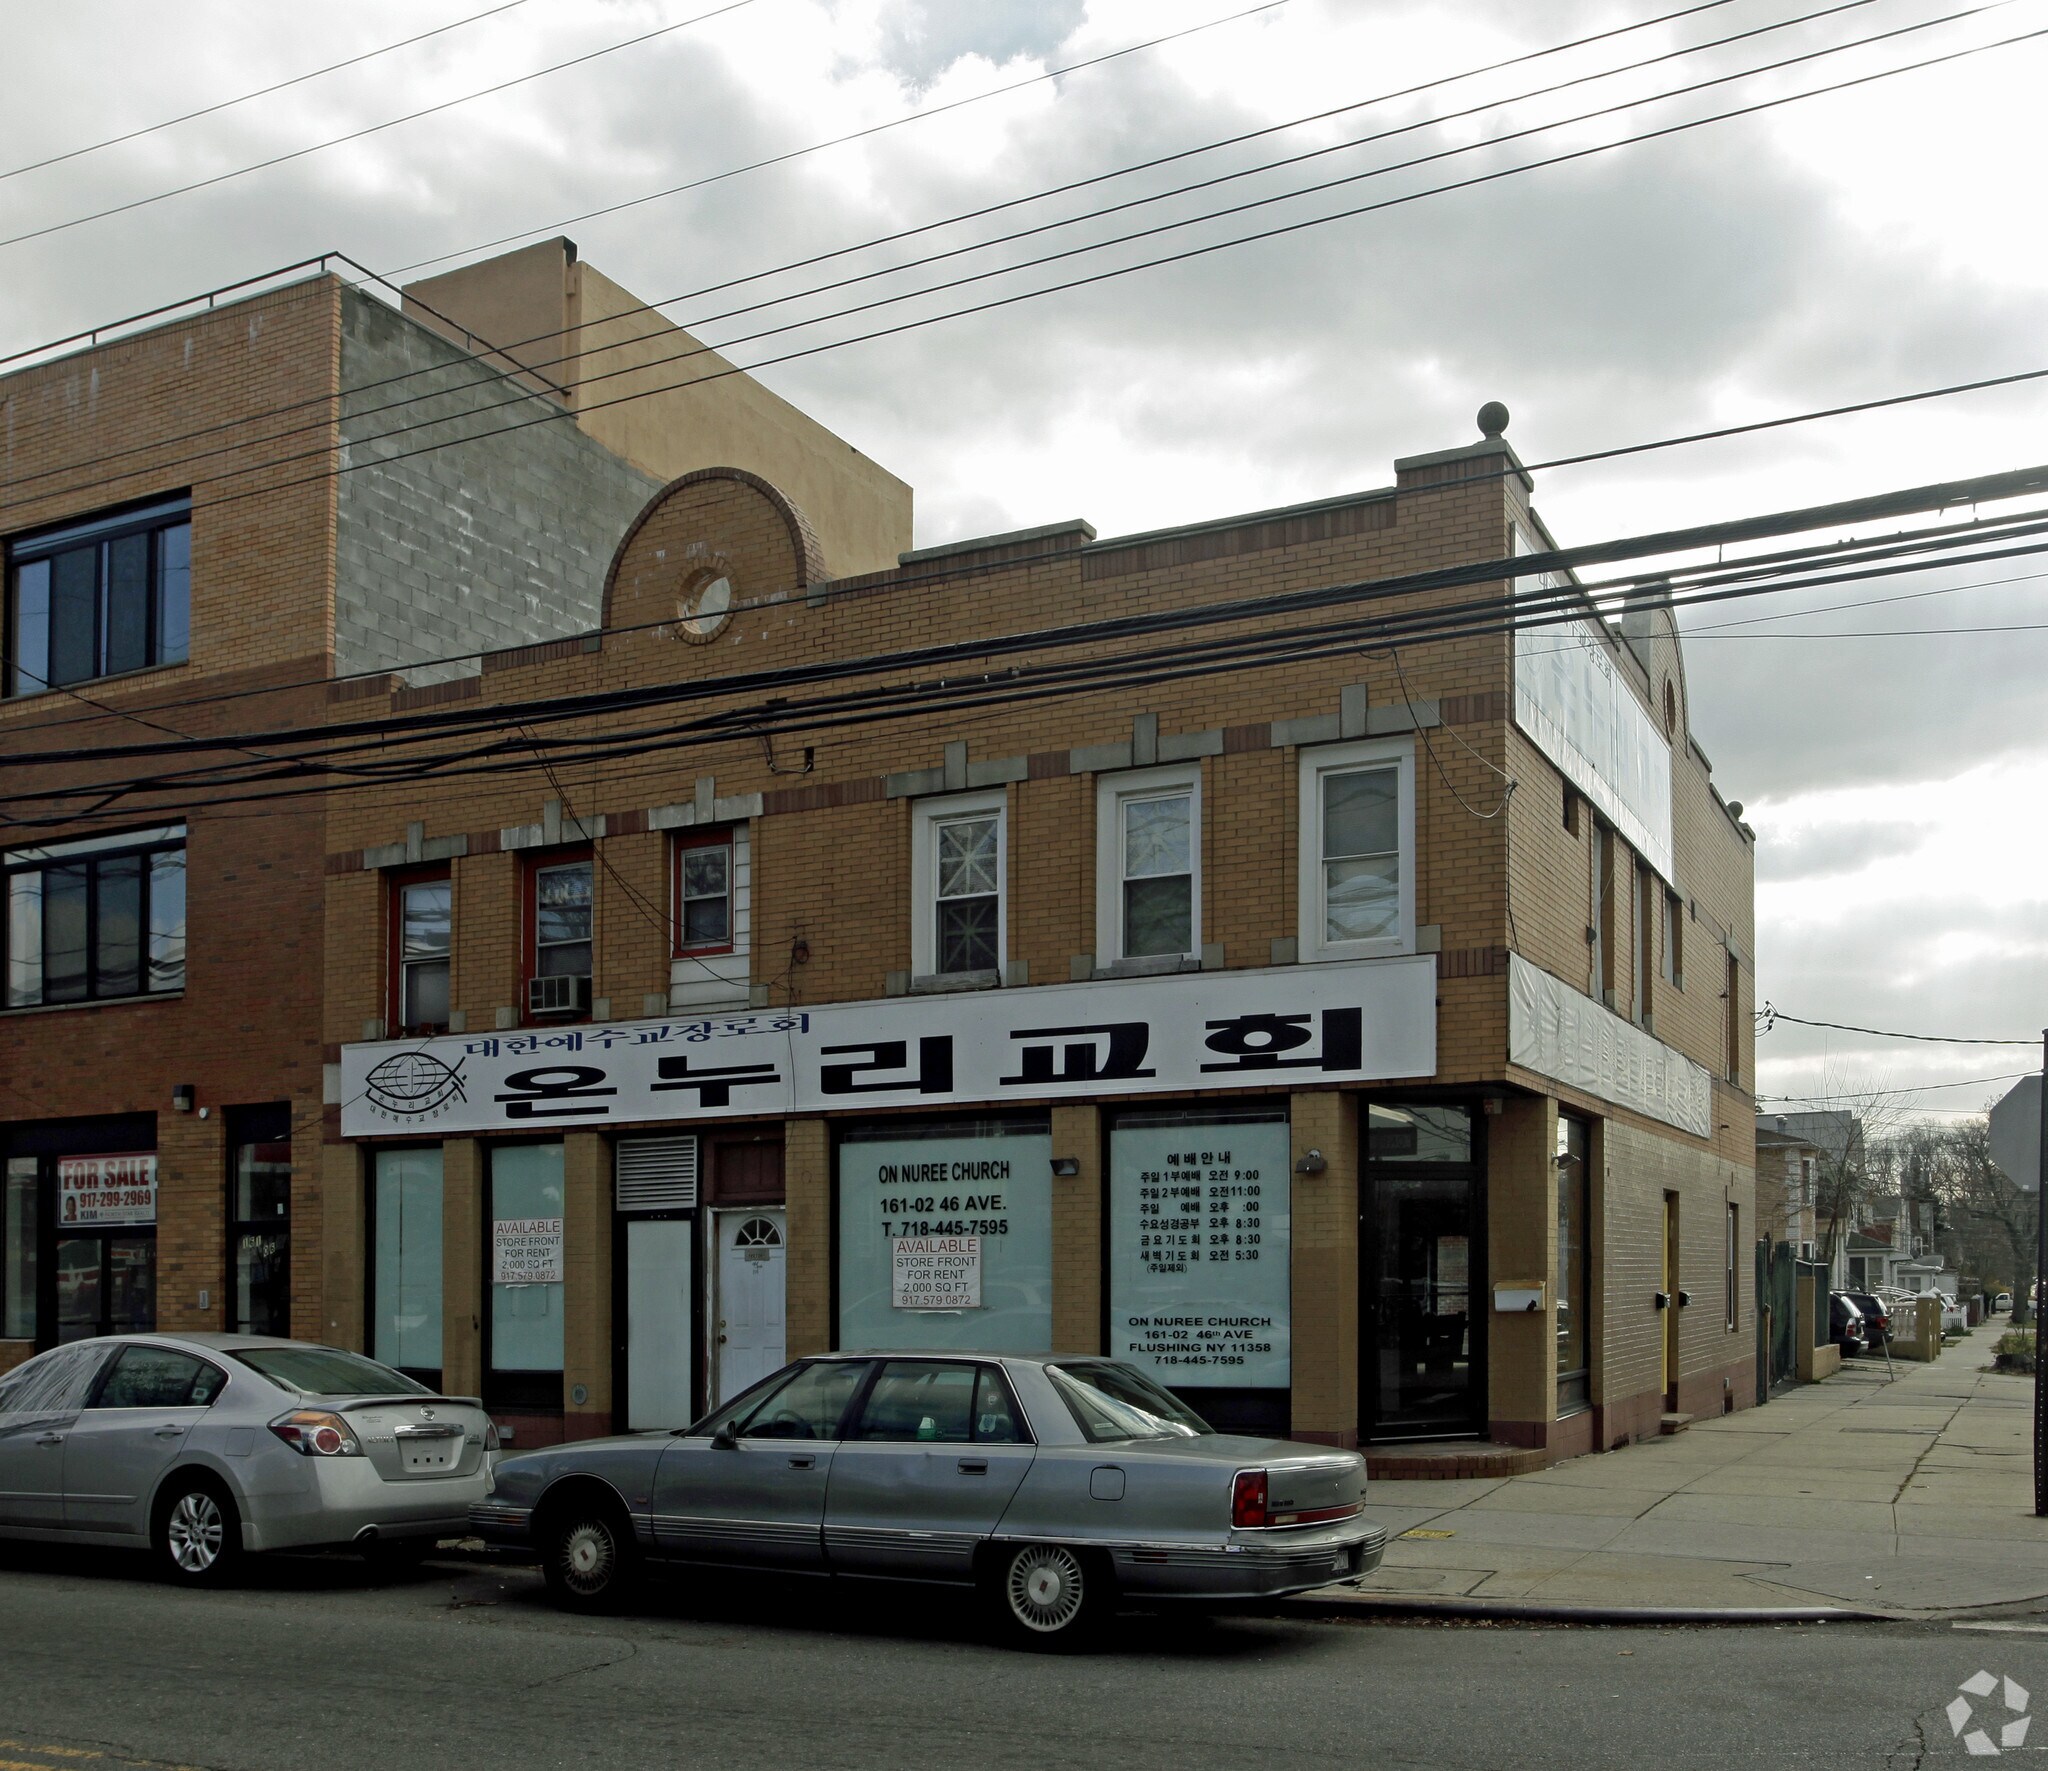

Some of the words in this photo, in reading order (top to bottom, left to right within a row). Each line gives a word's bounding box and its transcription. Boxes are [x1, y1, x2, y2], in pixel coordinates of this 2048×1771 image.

[464, 1013, 810, 1058] 대한예수교장로회
[494, 1007, 1362, 1119] 온누리교회
[63, 1162, 99, 1190] FOR
[104, 1159, 149, 1188] SALE
[879, 1165, 898, 1183] ON
[901, 1163, 948, 1182] NUREE
[952, 1160, 1010, 1181] CHURCH
[1208, 1170, 1229, 1181] 오전
[1234, 1169, 1259, 1180] 9:00
[1209, 1186, 1229, 1198] 오전
[1231, 1185, 1260, 1197] 11:00
[80, 1190, 152, 1208] 917-299-2969
[880, 1197, 934, 1213] 161-02
[939, 1196, 960, 1211] 46
[964, 1195, 1007, 1211] AVE.
[1140, 1203, 1160, 1214] 주일
[1180, 1202, 1200, 1213] 예배
[1209, 1202, 1229, 1213] 오후
[80, 1210, 98, 1220] KIM
[496, 1221, 560, 1234] AVAILABLE
[882, 1222, 896, 1237] T.
[902, 1219, 1009, 1236] 718-445-7595
[1209, 1218, 1229, 1229] 오후
[1235, 1217, 1260, 1229] 8:30
[496, 1237, 527, 1247] STORE
[529, 1236, 560, 1246] FRONT
[1209, 1234, 1229, 1245] 오후
[1235, 1233, 1261, 1244] 8:30
[896, 1239, 977, 1253] AVAILABLE
[505, 1249, 524, 1258] FOR
[526, 1248, 551, 1257] RENT
[1209, 1250, 1229, 1261] 오전
[1235, 1250, 1259, 1261] 5:30
[502, 1260, 525, 1270] 2,000
[527, 1260, 540, 1269] SQ
[543, 1259, 554, 1268] FT
[896, 1257, 934, 1267] STORE
[937, 1256, 977, 1267] FRONT
[501, 1271, 556, 1280] 917.579.0872
[907, 1270, 930, 1280] FOR
[934, 1269, 965, 1279] RENT
[903, 1283, 932, 1293] 2,000
[935, 1282, 952, 1293] SQ
[954, 1282, 968, 1291] FT
[901, 1295, 971, 1305] 917.579.0872
[1128, 1317, 1149, 1326] ON
[1153, 1317, 1203, 1326] NUREE
[1207, 1317, 1271, 1326] CHURCH
[1144, 1330, 1188, 1339] 161-02
[1196, 1330, 1221, 1339] 46th
[1223, 1330, 1253, 1339] AVE
[1129, 1343, 1201, 1352] FLUSHING
[1206, 1343, 1226, 1352] NY
[1231, 1343, 1271, 1352] 11358
[1154, 1355, 1244, 1365] 718-445-7595
